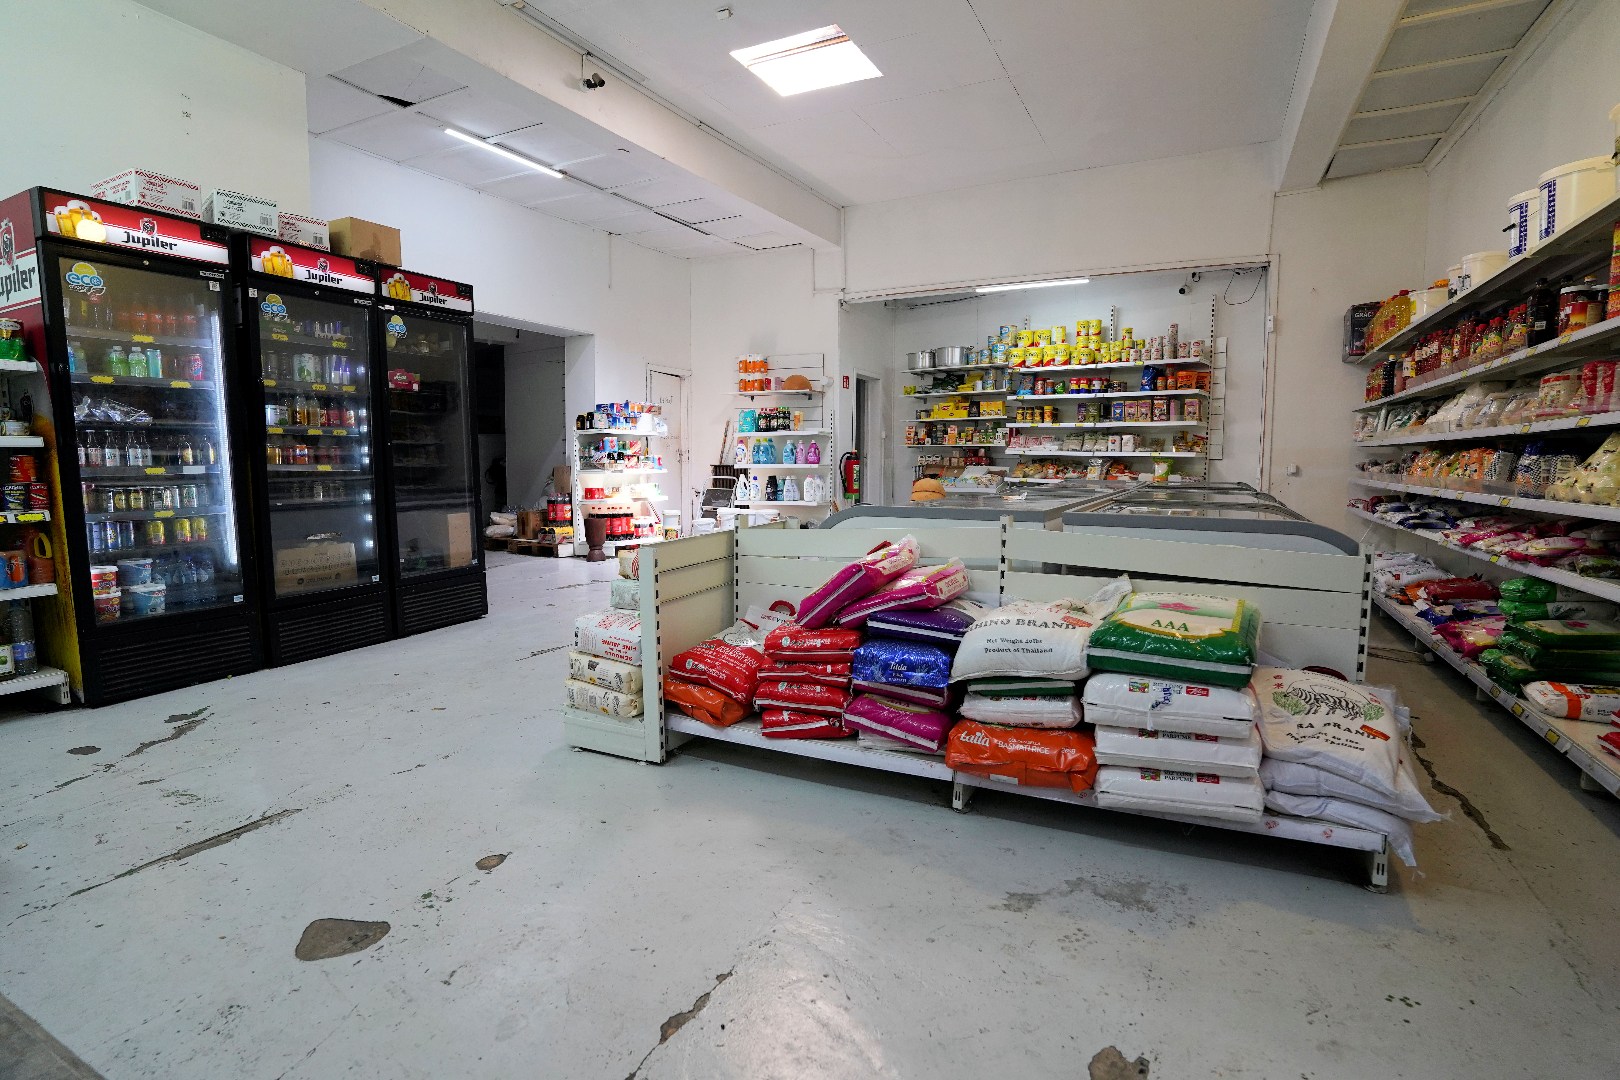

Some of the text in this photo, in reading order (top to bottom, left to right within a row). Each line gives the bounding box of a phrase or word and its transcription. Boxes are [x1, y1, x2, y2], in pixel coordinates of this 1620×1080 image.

[120, 231, 178, 251] Jupiler
[0, 263, 36, 303] upiler
[66, 272, 104, 287] eco
[304, 269, 343, 285] Jupiler
[419, 292, 448, 305] Jupiler
[260, 301, 287, 314] eco
[1150, 619, 1190, 633] AAA
[998, 741, 1050, 755] BASMATI RICE
